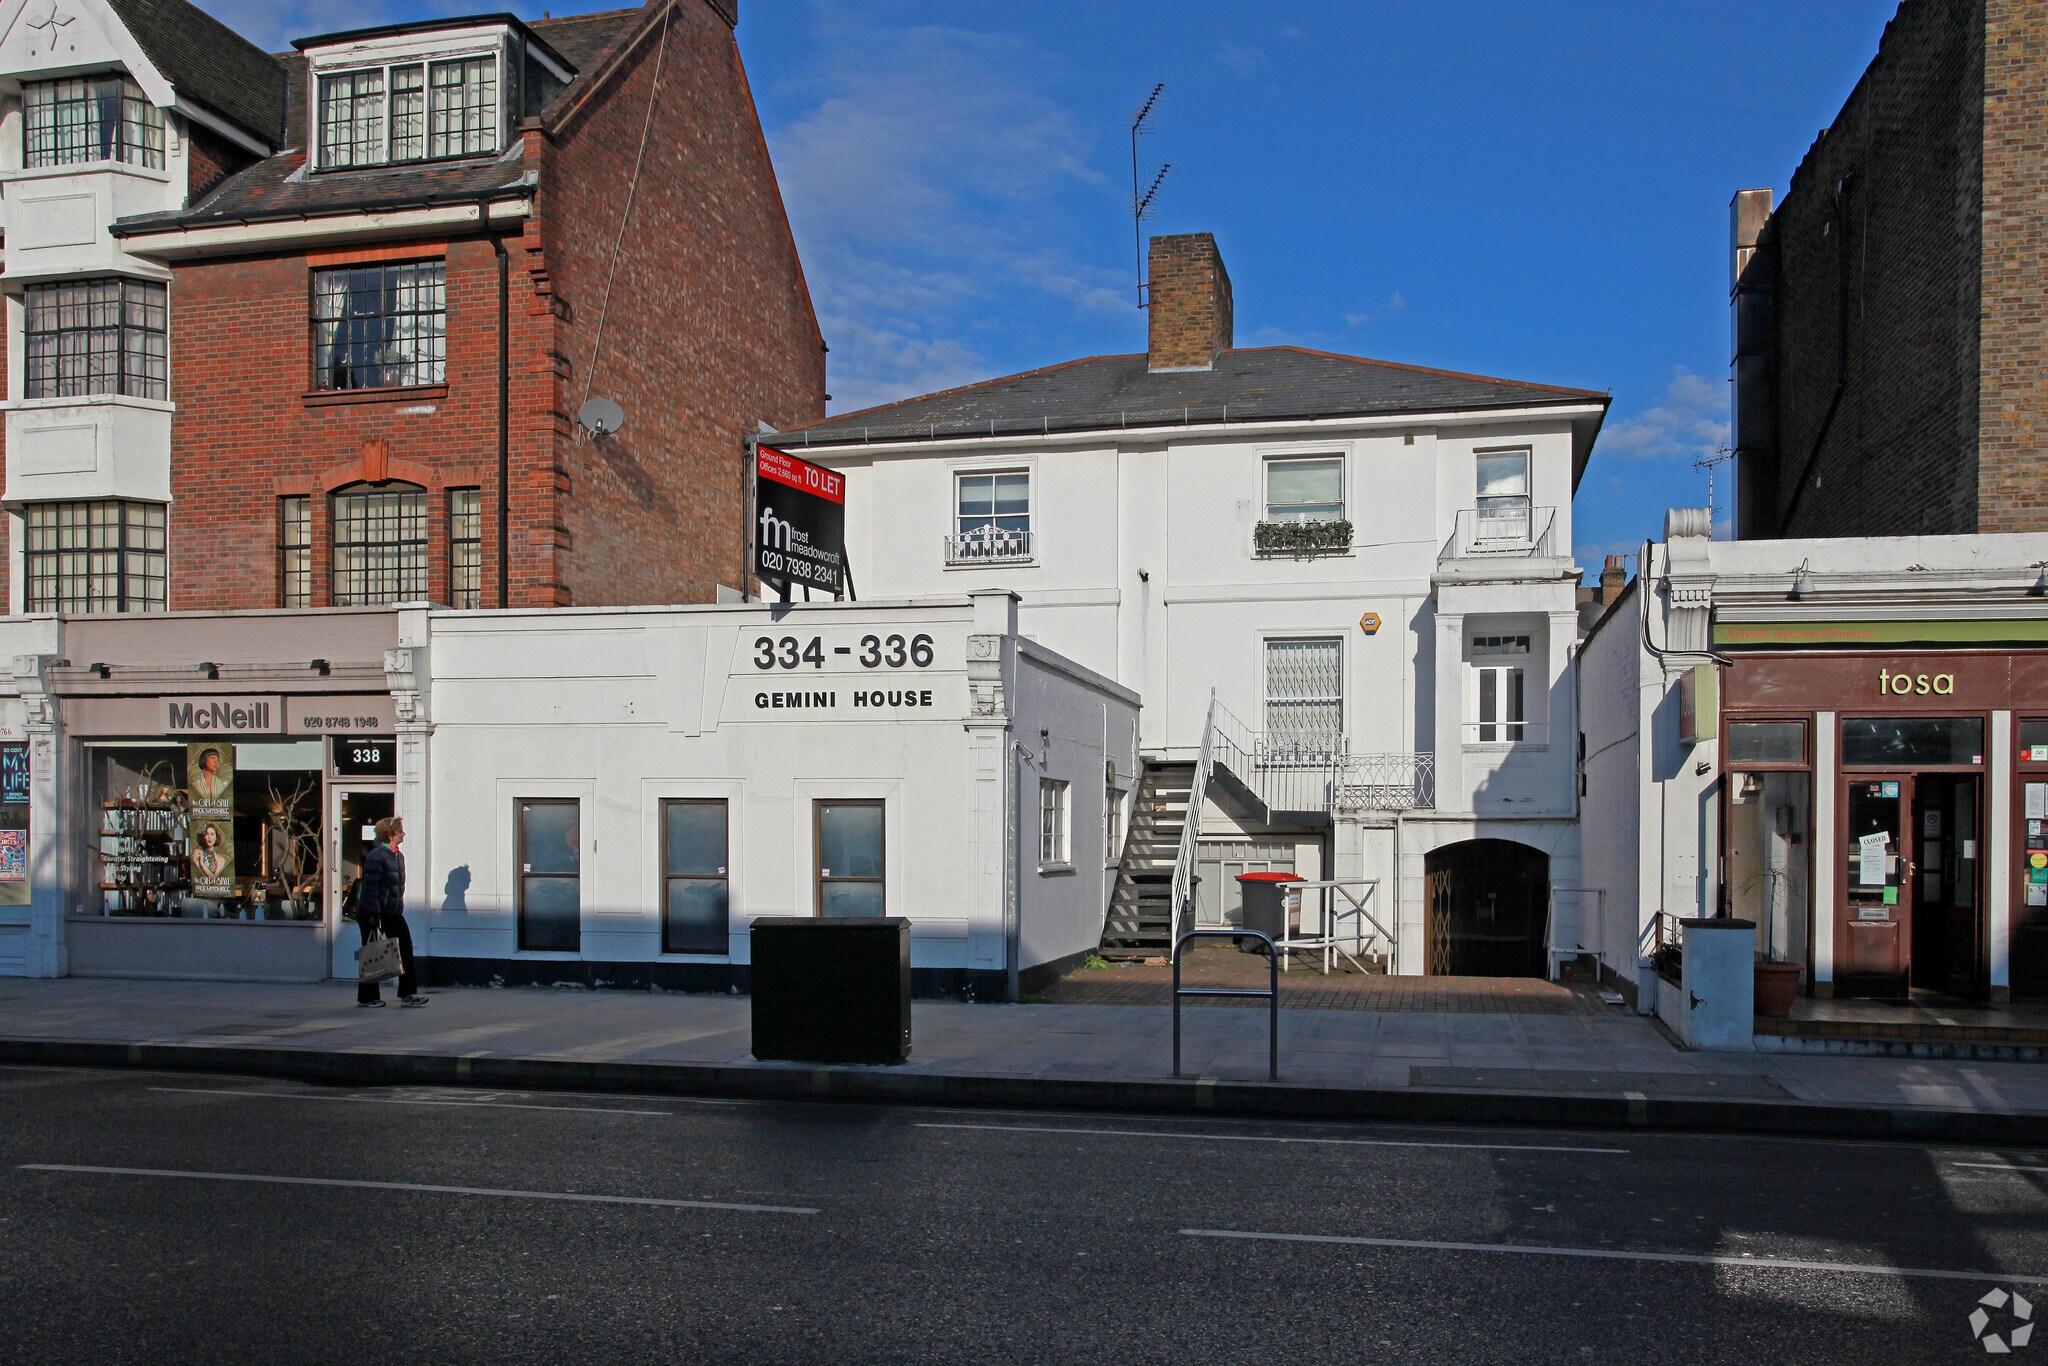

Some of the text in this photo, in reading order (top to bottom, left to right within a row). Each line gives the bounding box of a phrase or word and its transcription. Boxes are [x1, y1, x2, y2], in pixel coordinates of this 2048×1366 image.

[760, 449, 791, 469] Ground Floor
[760, 461, 802, 484] Offices 2,660 sq ft
[804, 466, 840, 496] TO LET
[760, 507, 791, 552] fm
[791, 527, 809, 544] frost
[791, 542, 840, 566] meadowcroft
[762, 550, 837, 586] 020 7938 2341
[1725, 628, 1874, 641] Authentic Japanese Restaurant
[1879, 668, 1954, 695] tosa
[754, 690, 933, 709] GEMINI HOUSE
[169, 702, 269, 728] McNeill
[304, 717, 379, 728] 020 8748 1948
[3, 745, 30, 771] MY
[353, 749, 380, 763] 338
[3, 772, 30, 790] LIFE
[1863, 835, 1887, 846] CLOSED
[127, 855, 169, 864] Straightening
